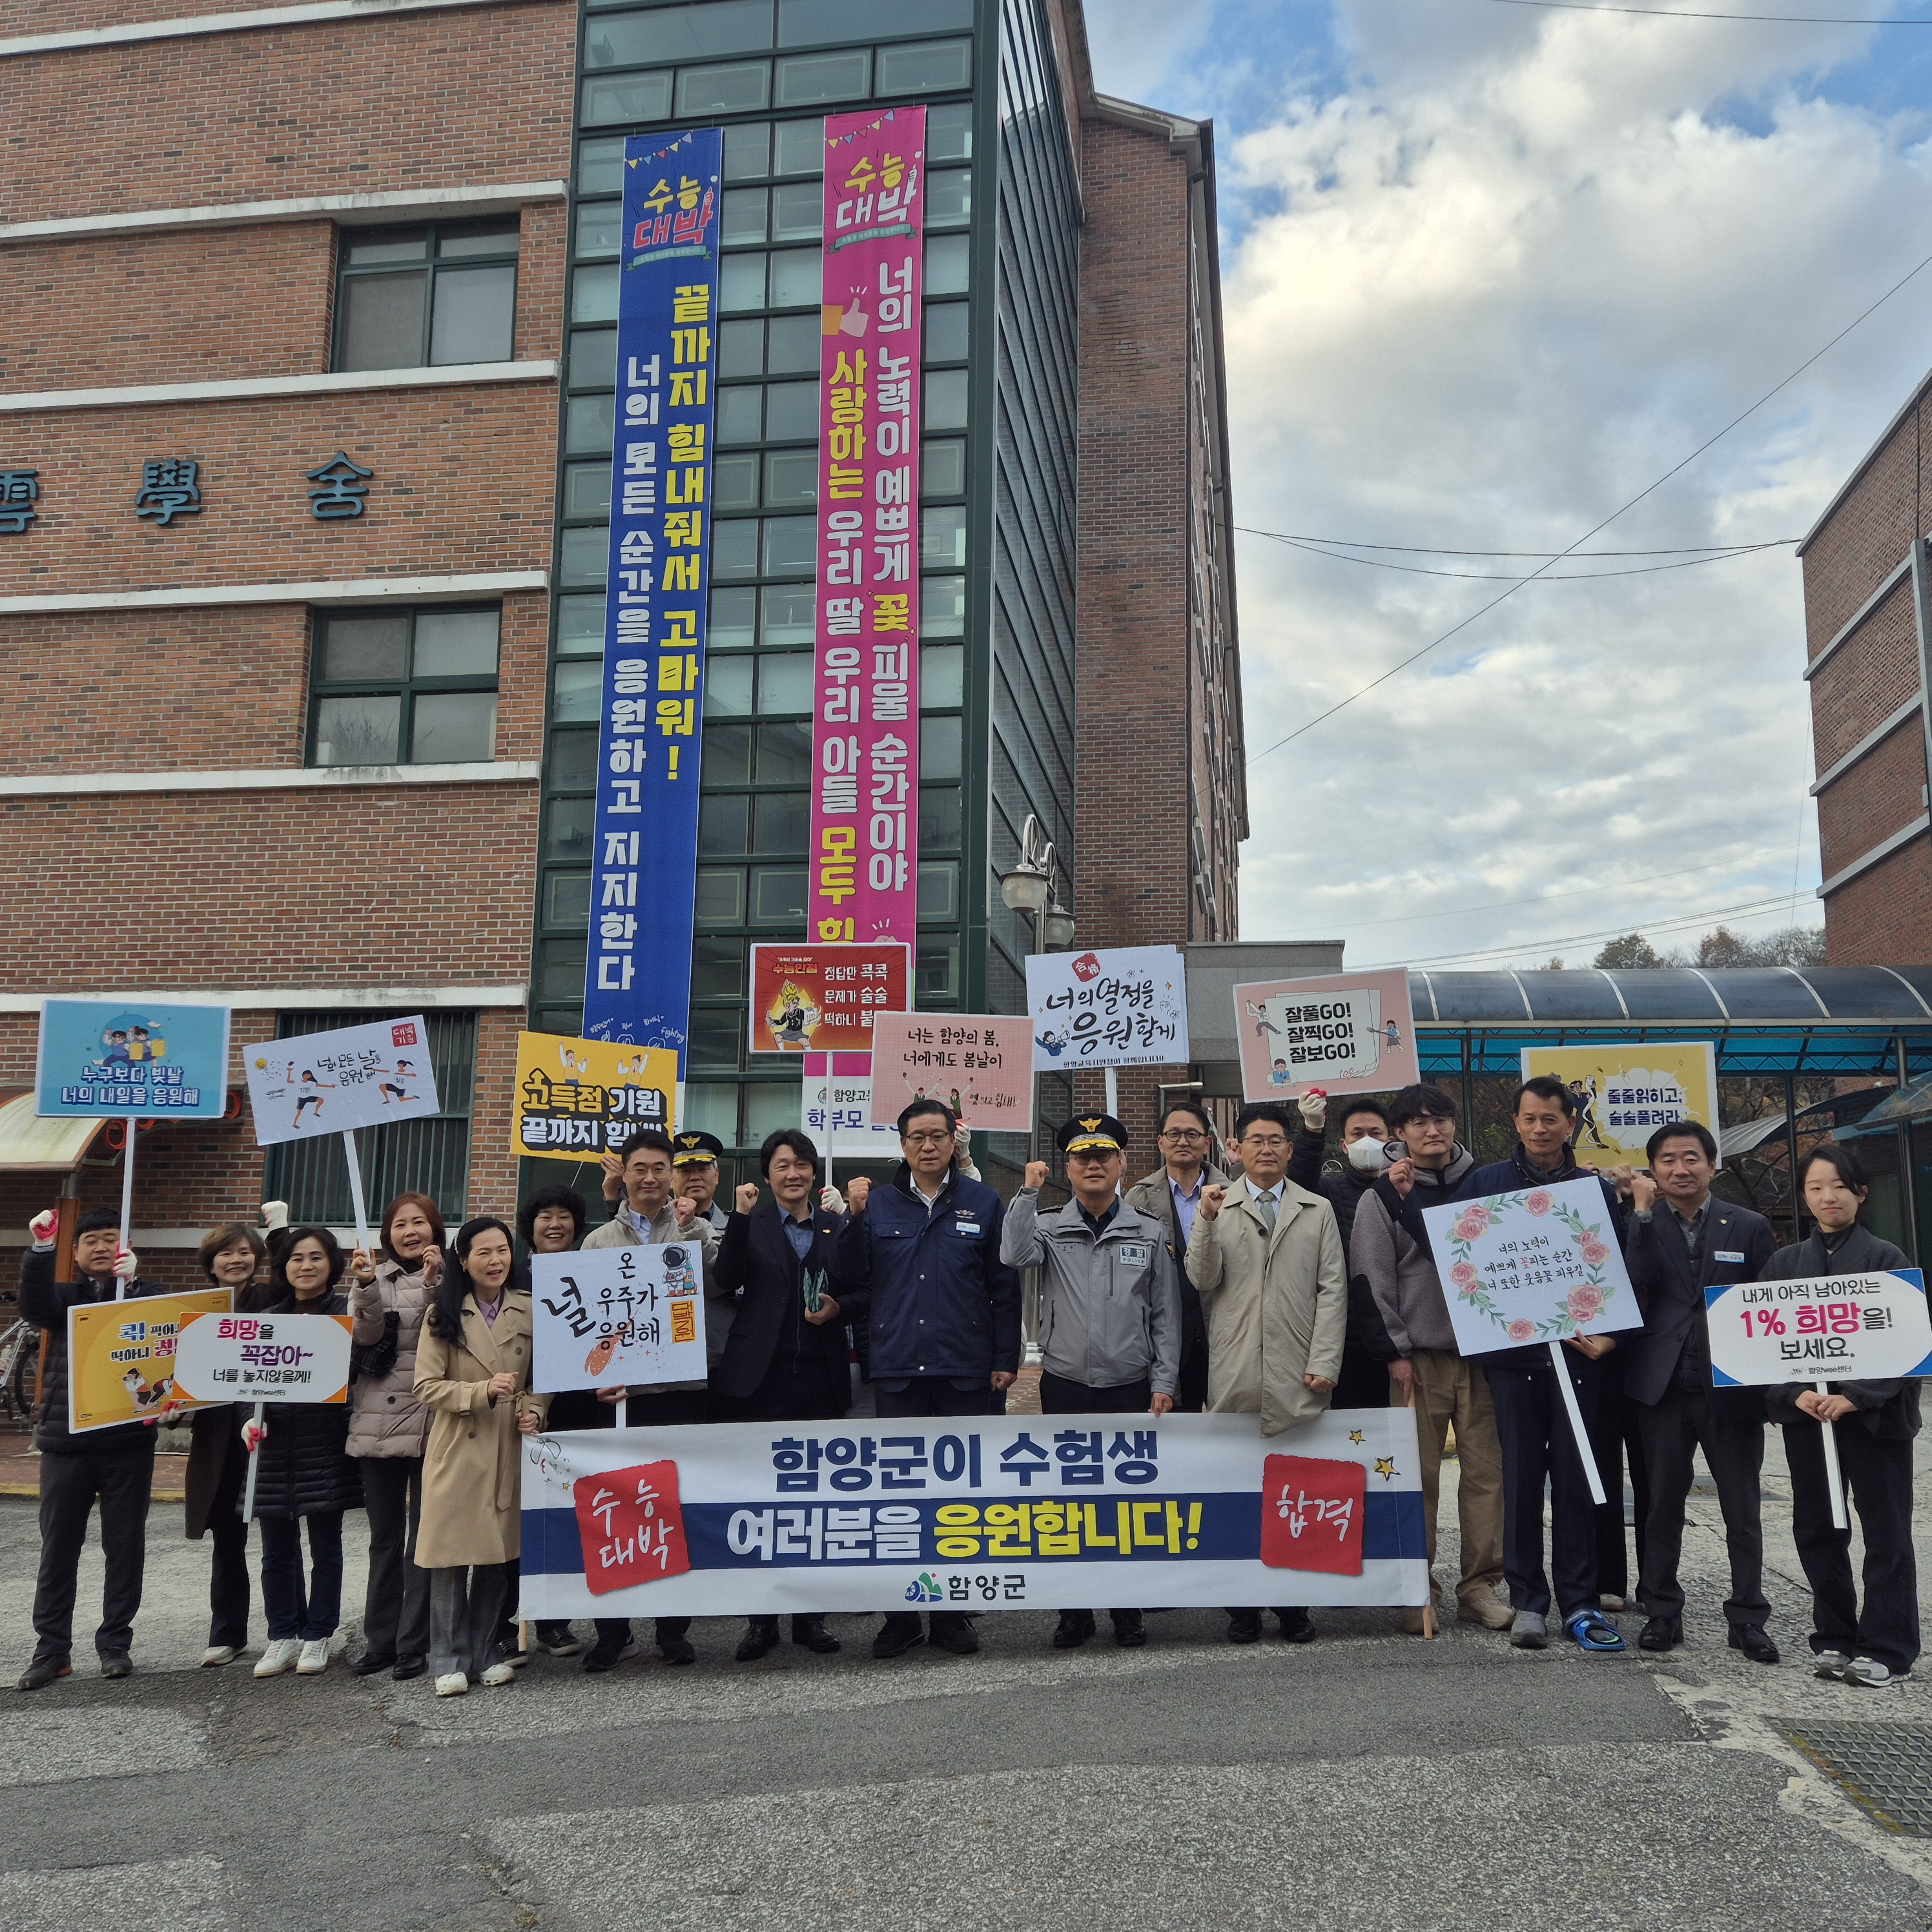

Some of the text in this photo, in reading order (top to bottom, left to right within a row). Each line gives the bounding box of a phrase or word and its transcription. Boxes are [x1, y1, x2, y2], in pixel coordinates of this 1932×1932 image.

[845, 152, 905, 194] 수능
[644, 175, 701, 214] 수능
[836, 165, 917, 229] 대박
[633, 187, 714, 249] 대박
[828, 349, 868, 499] 사랑하는
[655, 284, 711, 780] 끝까지 힘내줘서 고마워!
[827, 510, 863, 585] 우리
[869, 256, 913, 891] 너의 노력이 예쁘게 꽃 피울 순간이야
[826, 597, 864, 635] 딸
[597, 355, 660, 990] 너의 모든 순간을 응원하고 지지한다
[824, 647, 861, 723] 우리
[821, 735, 861, 814] 아들
[819, 826, 857, 905] 모두
[772, 963, 818, 974] 수능만점
[825, 963, 888, 981] 정답만 콕콕
[825, 986, 888, 1004] 문제가 술술
[1046, 978, 1155, 1015] 너의 열정을
[825, 1012, 856, 1027] 떡하니
[1285, 1002, 1351, 1023] 잘풀GO!
[393, 1025, 413, 1036] 대박
[908, 1027, 999, 1047] 너는 함양의 봄,
[1071, 1012, 1175, 1056] 응원할게
[1287, 1022, 1353, 1043] 잘찍GO!
[338, 1053, 355, 1069] 모든
[358, 1049, 382, 1070] 날을
[904, 1051, 1002, 1069] 너에게도 봄날이
[1289, 1042, 1356, 1064] 잘보GO!
[82, 1067, 183, 1084] 누구보다 빛날
[339, 1069, 376, 1087] 응원해
[61, 1087, 200, 1107] 너의 내일을 응원해
[522, 1069, 661, 1116] 고득점 기원
[834, 1089, 870, 1103] 함양고
[1608, 1088, 1682, 1104] 줄줄읽히고,
[807, 1109, 864, 1131] 학부모
[1609, 1109, 1680, 1126] 술술풀려라
[522, 1117, 598, 1146] 끝까지
[1124, 1247, 1144, 1259] 경찰
[1499, 1236, 1549, 1253] 너의 노력이
[617, 1252, 636, 1279] 온
[1485, 1249, 1572, 1274] 예쁘게 꽃피는 순간
[1488, 1264, 1584, 1291] 너 또한 웃음꽃 피우길
[597, 1282, 658, 1321] 우주가
[1742, 1279, 1881, 1304] 내게 아직 남아있는
[540, 1277, 596, 1338] 널
[1740, 1302, 1893, 1338] 1% 희망을!
[119, 1322, 145, 1341] 콕!
[216, 1319, 274, 1341] 희망을
[595, 1317, 660, 1350] 응원해
[111, 1346, 150, 1362] 떡하니
[240, 1345, 314, 1366] 꼭잡아~
[1780, 1337, 1855, 1360] 보세요.
[213, 1368, 311, 1384] 너를 놓지않을께!
[772, 1429, 1159, 1492] 함양군이 수험생
[592, 1479, 660, 1537] 수능
[1276, 1485, 1353, 1541] 합격
[727, 1501, 1203, 1561] 여러분을 응원합니다!
[599, 1519, 674, 1570] 대박
[948, 1575, 1026, 1600] 함양군
